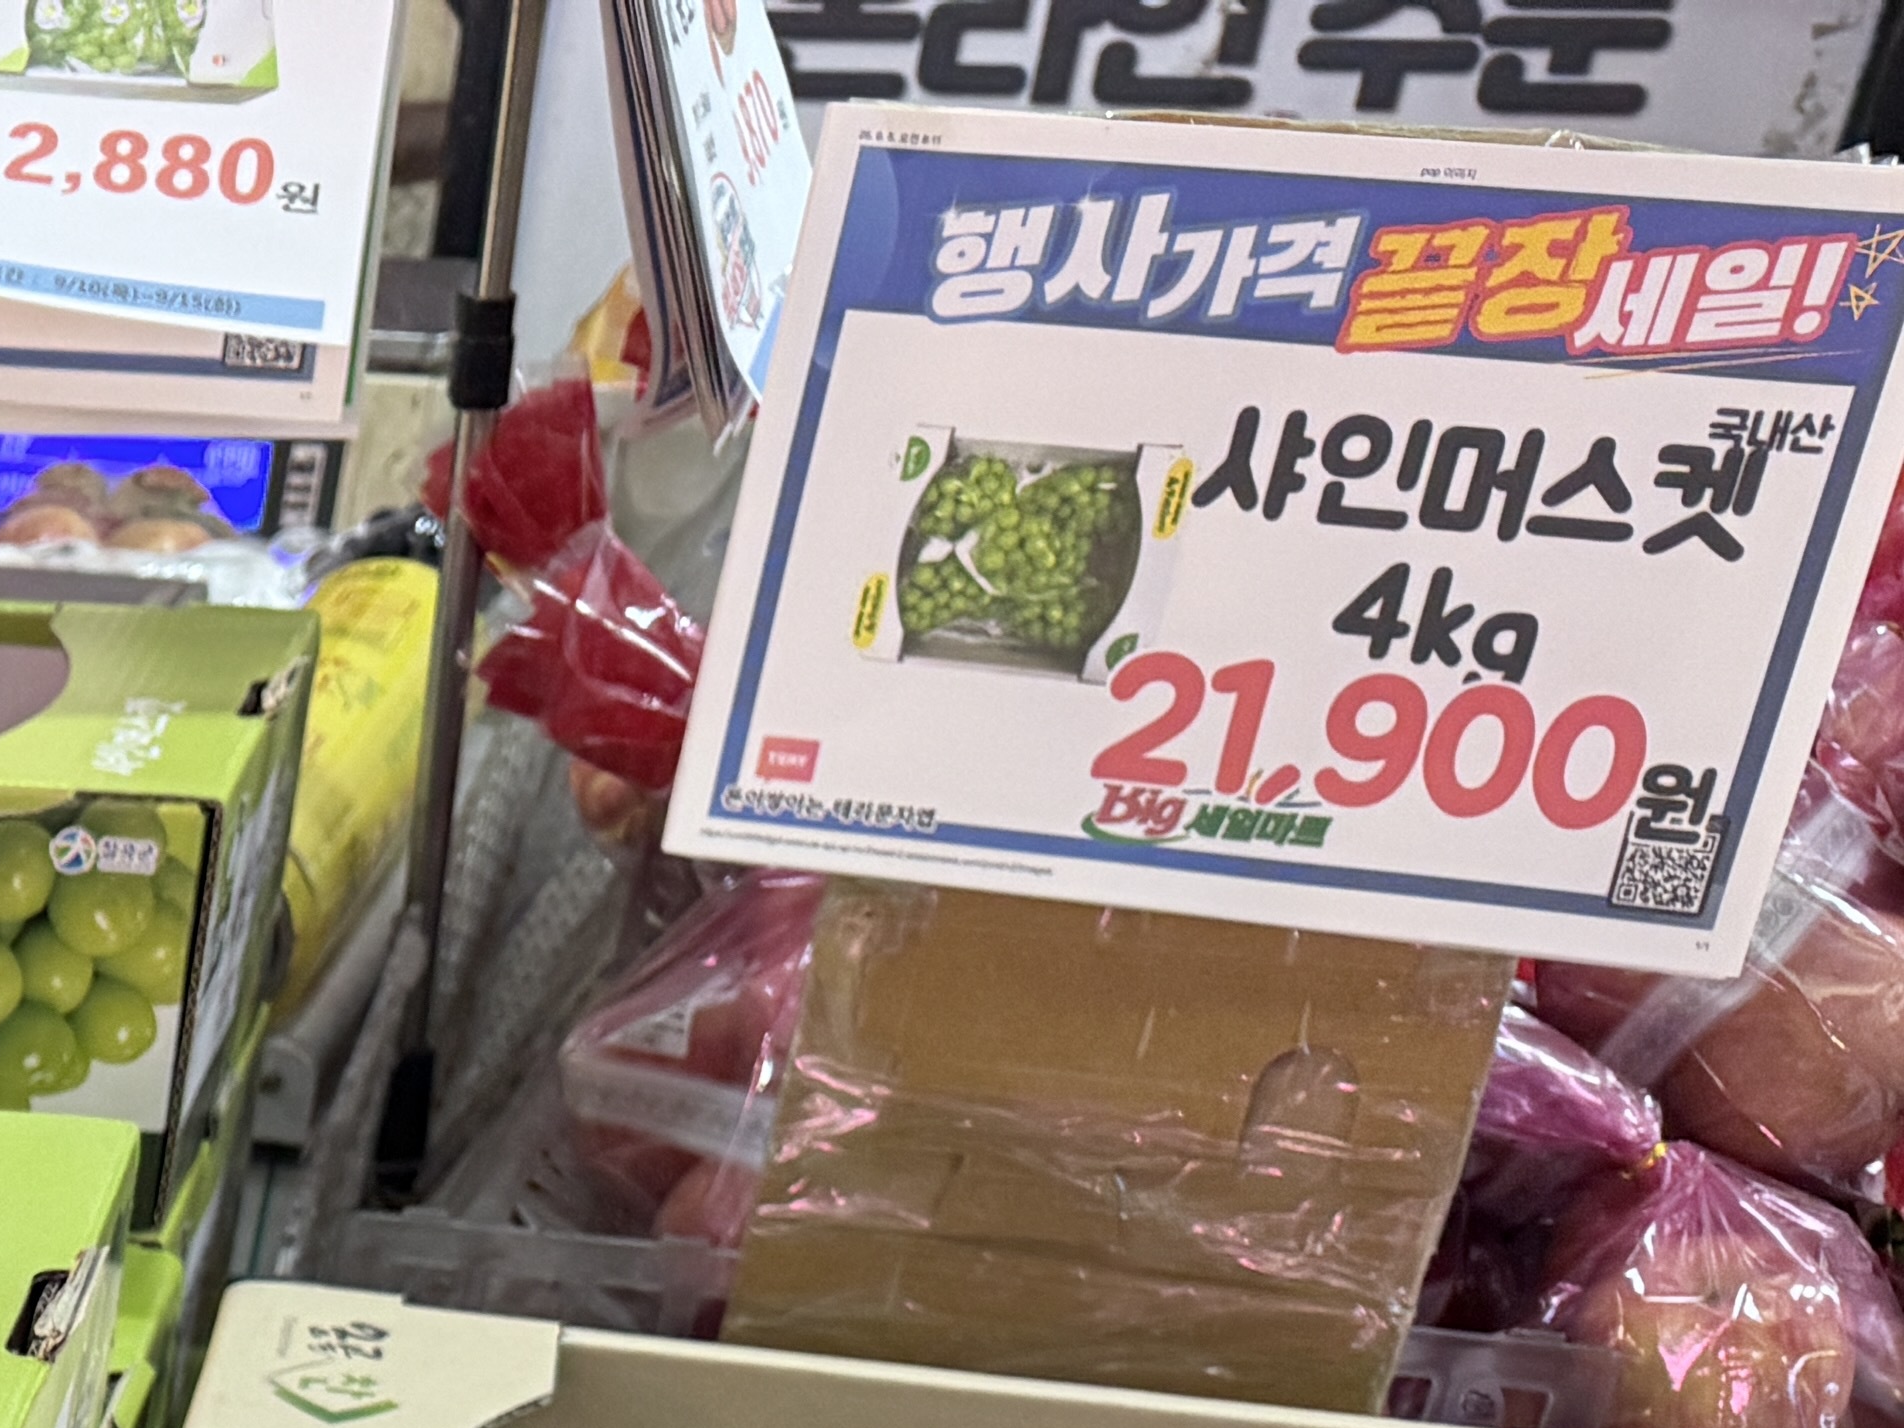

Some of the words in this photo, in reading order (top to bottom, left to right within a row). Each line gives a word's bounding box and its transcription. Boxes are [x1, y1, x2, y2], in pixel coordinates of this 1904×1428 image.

[276, 178, 320, 215] 원
[925, 185, 1361, 323] 행사가격
[1335, 205, 1863, 354] 끝장세일!
[1191, 405, 1774, 563] 샤인머스켓
[1709, 408, 1835, 453] 국내산
[1332, 563, 1542, 686] 4kg
[1091, 651, 1648, 831] 21,900
[1635, 765, 1717, 844] 원
